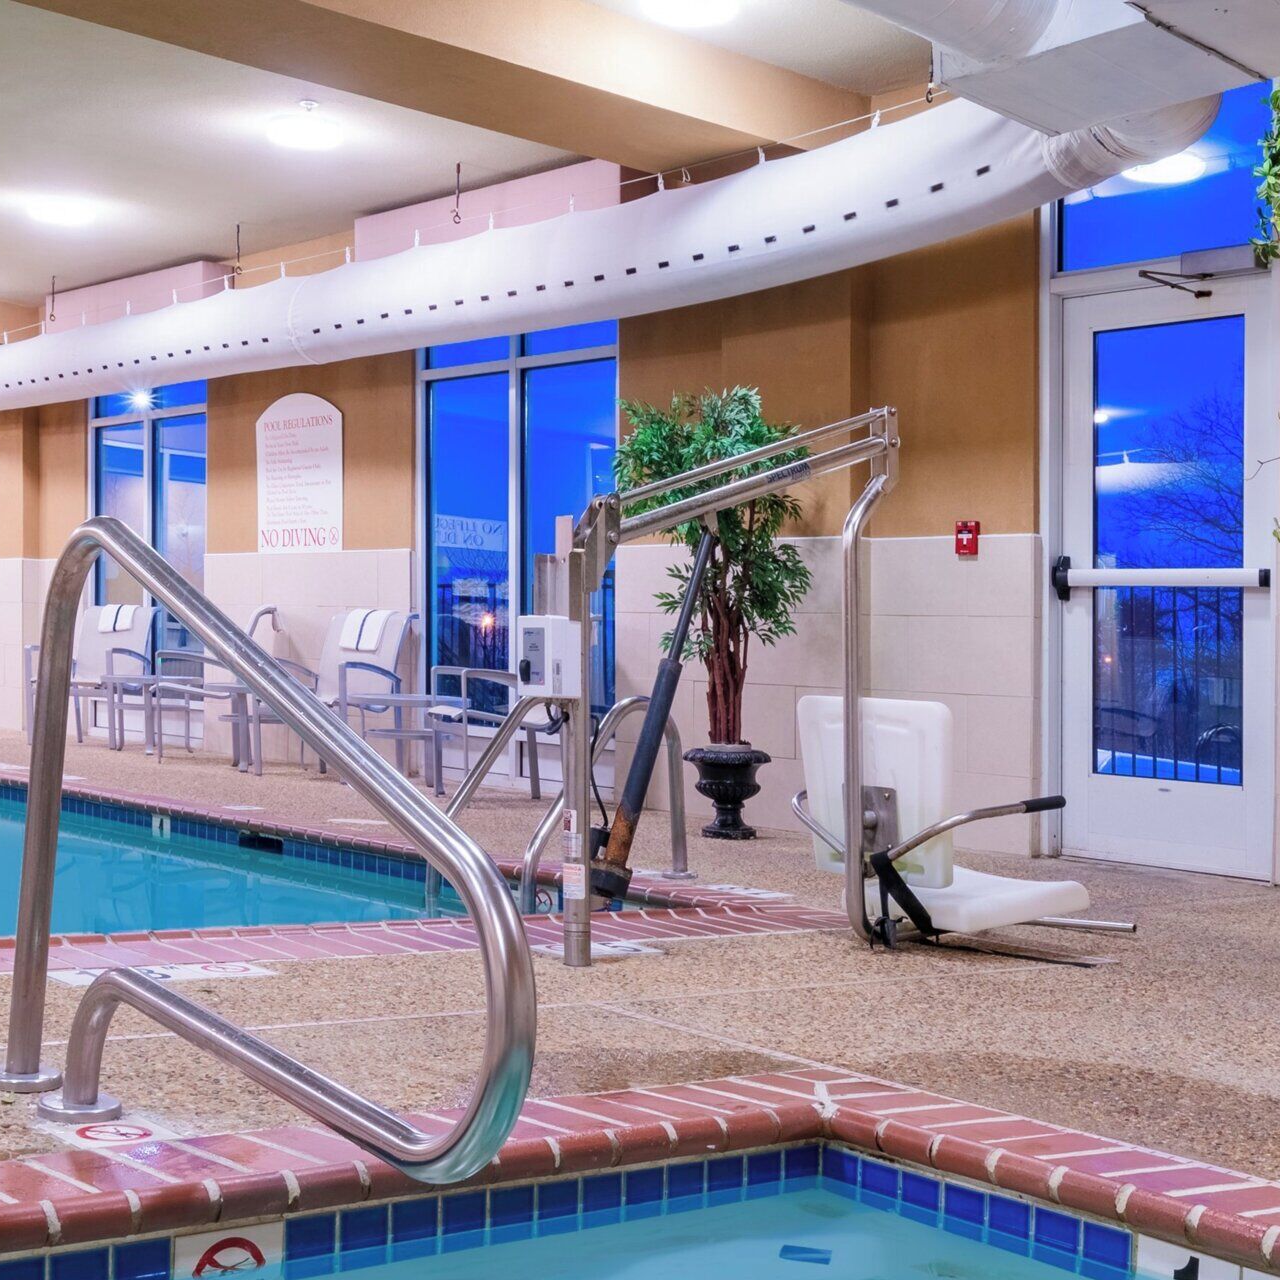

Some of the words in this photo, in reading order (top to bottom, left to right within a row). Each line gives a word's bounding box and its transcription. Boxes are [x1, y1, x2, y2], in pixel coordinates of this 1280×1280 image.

[264, 421, 282, 432] POOL
[283, 415, 334, 430] REGULATIONS
[261, 528, 279, 548] NO
[282, 527, 327, 547] DIVING
